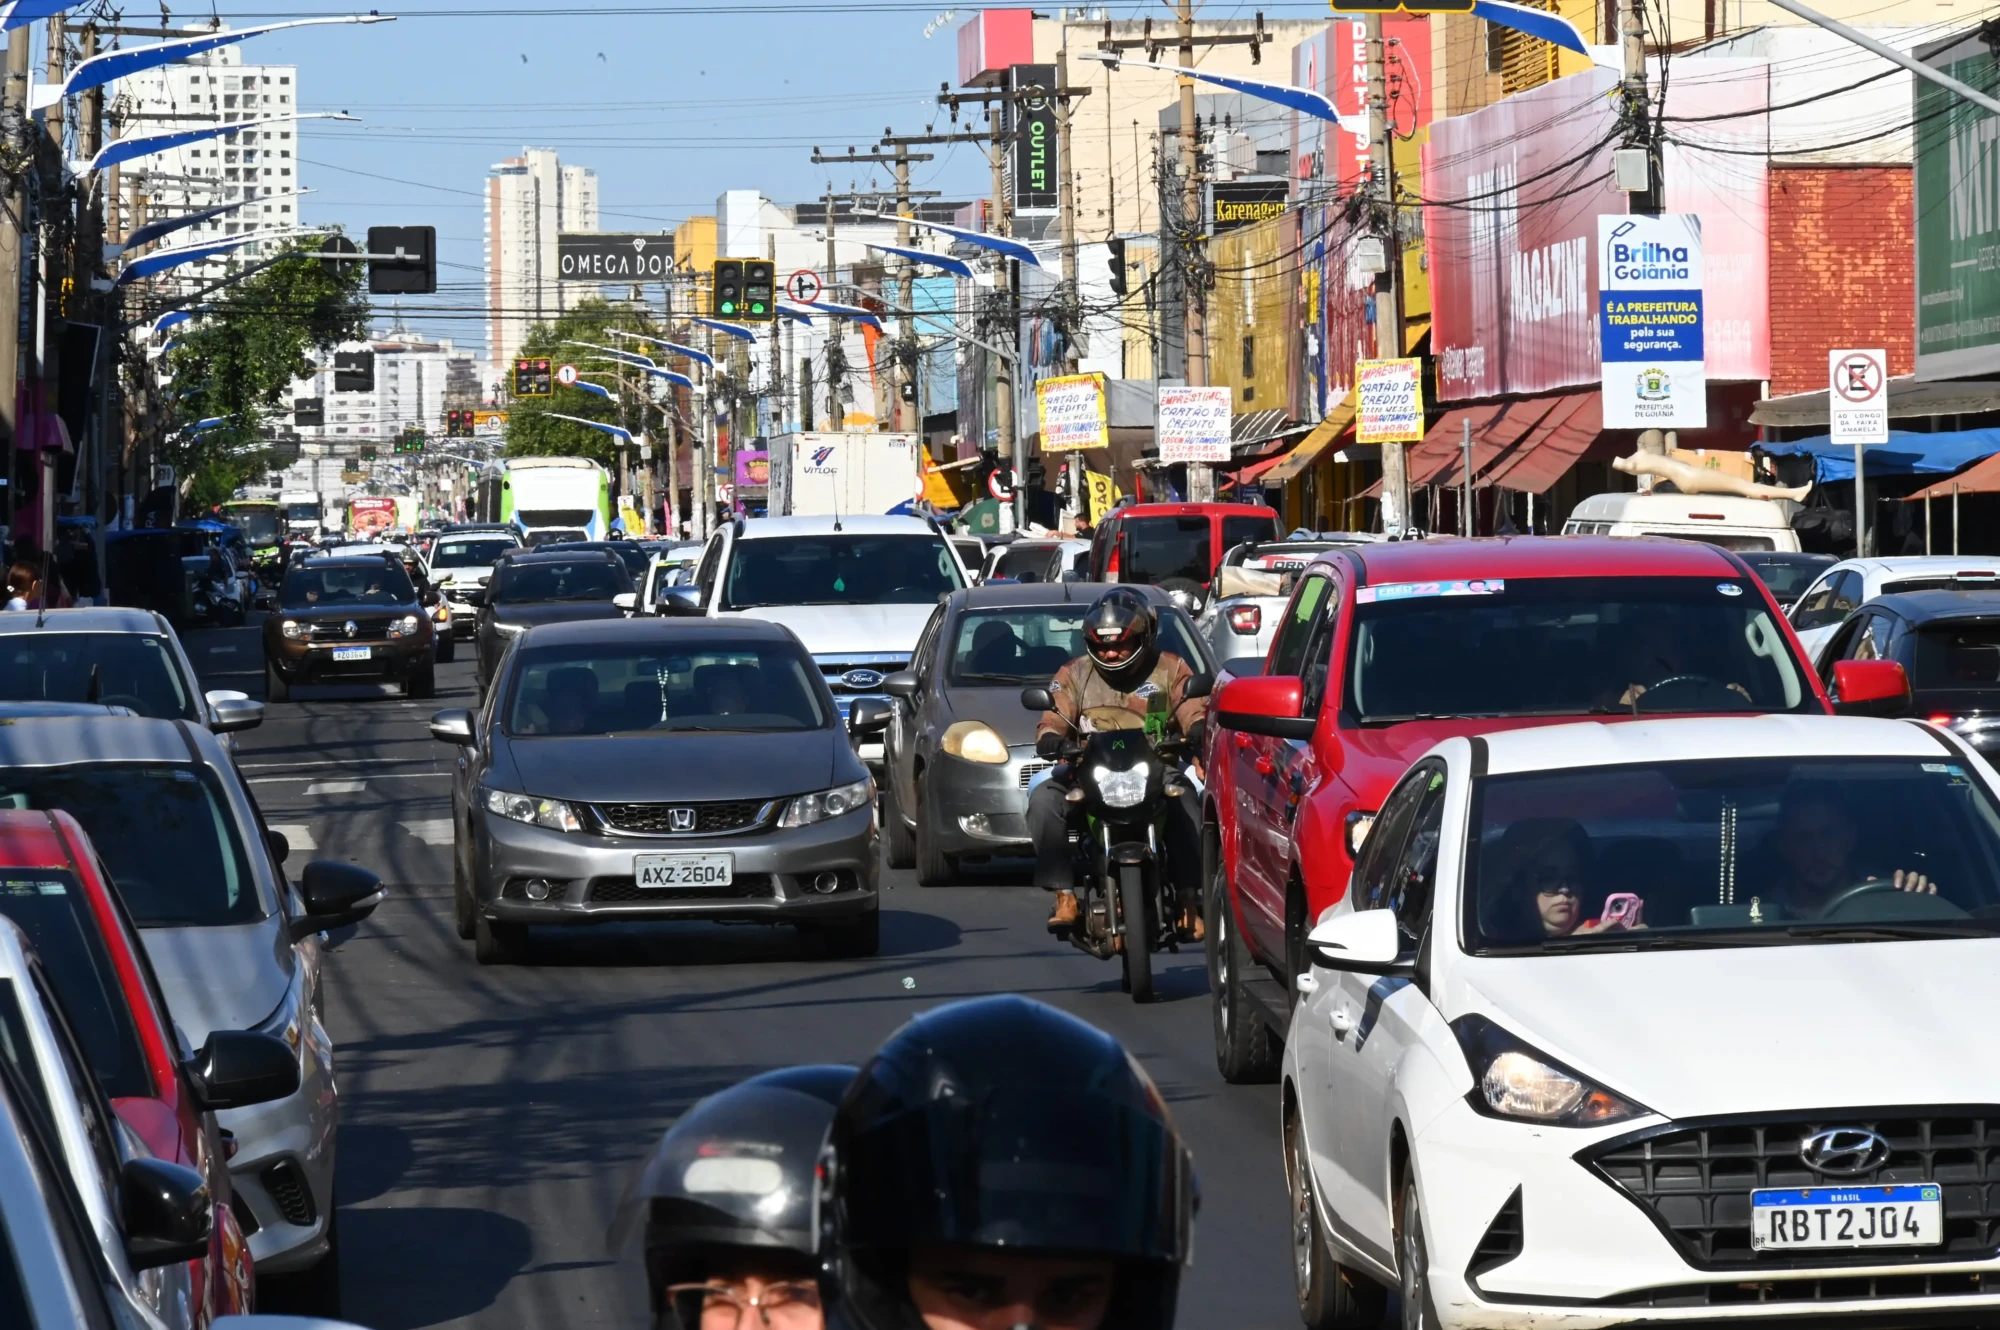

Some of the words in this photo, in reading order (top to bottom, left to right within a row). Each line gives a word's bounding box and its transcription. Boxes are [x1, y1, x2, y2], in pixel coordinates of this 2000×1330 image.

[1031, 121, 1045, 190] OUTLET
[1614, 241, 1688, 263] Brilha
[561, 254, 629, 274] OMEGA
[1615, 263, 1689, 280] Goiânia
[1510, 236, 1587, 323] MAGAZINE
[1606, 301, 1614, 313] É
[1616, 303, 1625, 313] A
[1627, 302, 1698, 312] PREFEITURA
[1607, 314, 1697, 325] TRABALHANDO
[1630, 326, 1654, 340] pela
[1656, 329, 1675, 337] sua
[1623, 340, 1682, 352] segurança.
[1357, 380, 1399, 393] CARTÃO
[1402, 381, 1418, 392] DE
[1039, 392, 1080, 405] CARTÃO
[1085, 393, 1099, 401] DE
[1361, 393, 1409, 405] CRÉDITO
[1044, 403, 1088, 415] CRÉDITO
[1161, 405, 1210, 417] CARTÃO
[1213, 407, 1228, 417] DE
[1166, 417, 1215, 429] CRÉDITO
[1411, 583, 1441, 595] 22
[1830, 1194, 1861, 1202] BRASIL
[1770, 1205, 1920, 1243] RBT2J04
[1755, 1237, 1766, 1247] BR
